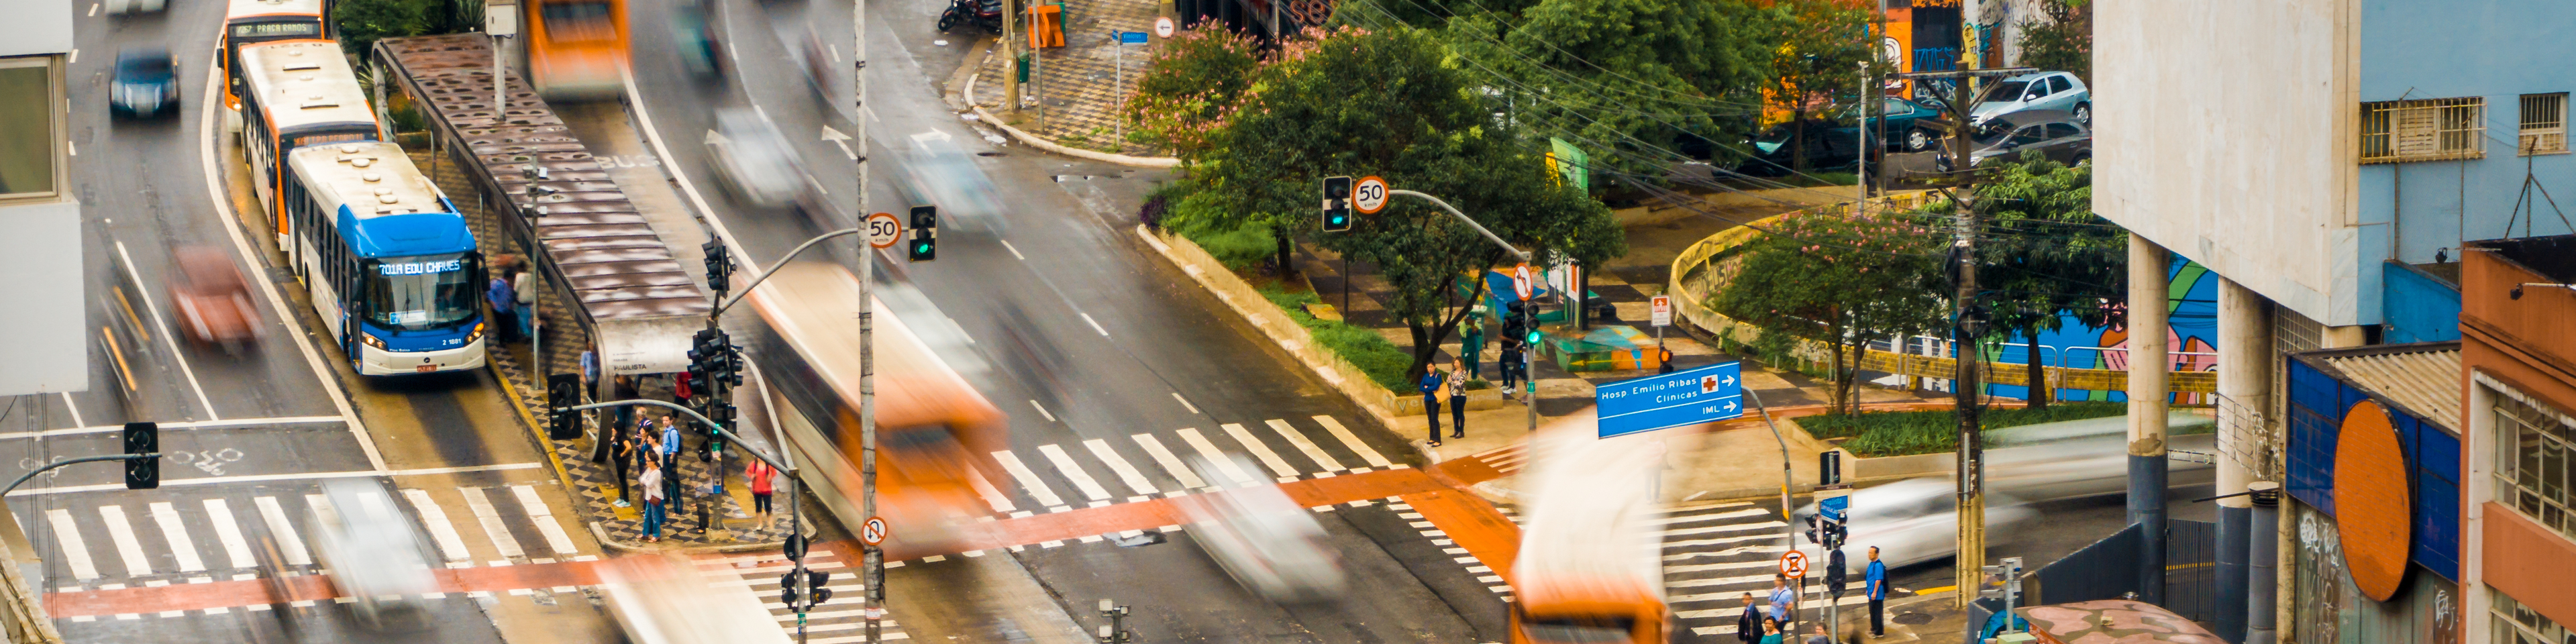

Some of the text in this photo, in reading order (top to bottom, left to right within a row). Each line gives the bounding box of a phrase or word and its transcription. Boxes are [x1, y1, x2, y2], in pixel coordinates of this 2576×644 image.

[282, 23, 307, 32] RAMOS
[1359, 184, 1382, 201] 50
[870, 221, 895, 236] 50
[378, 260, 460, 275] 701A EDU CHAVES
[1602, 378, 1697, 400] Hosp. Emílio Ribas
[1656, 390, 1698, 403] Clínicas
[1702, 405, 1720, 415] IML
